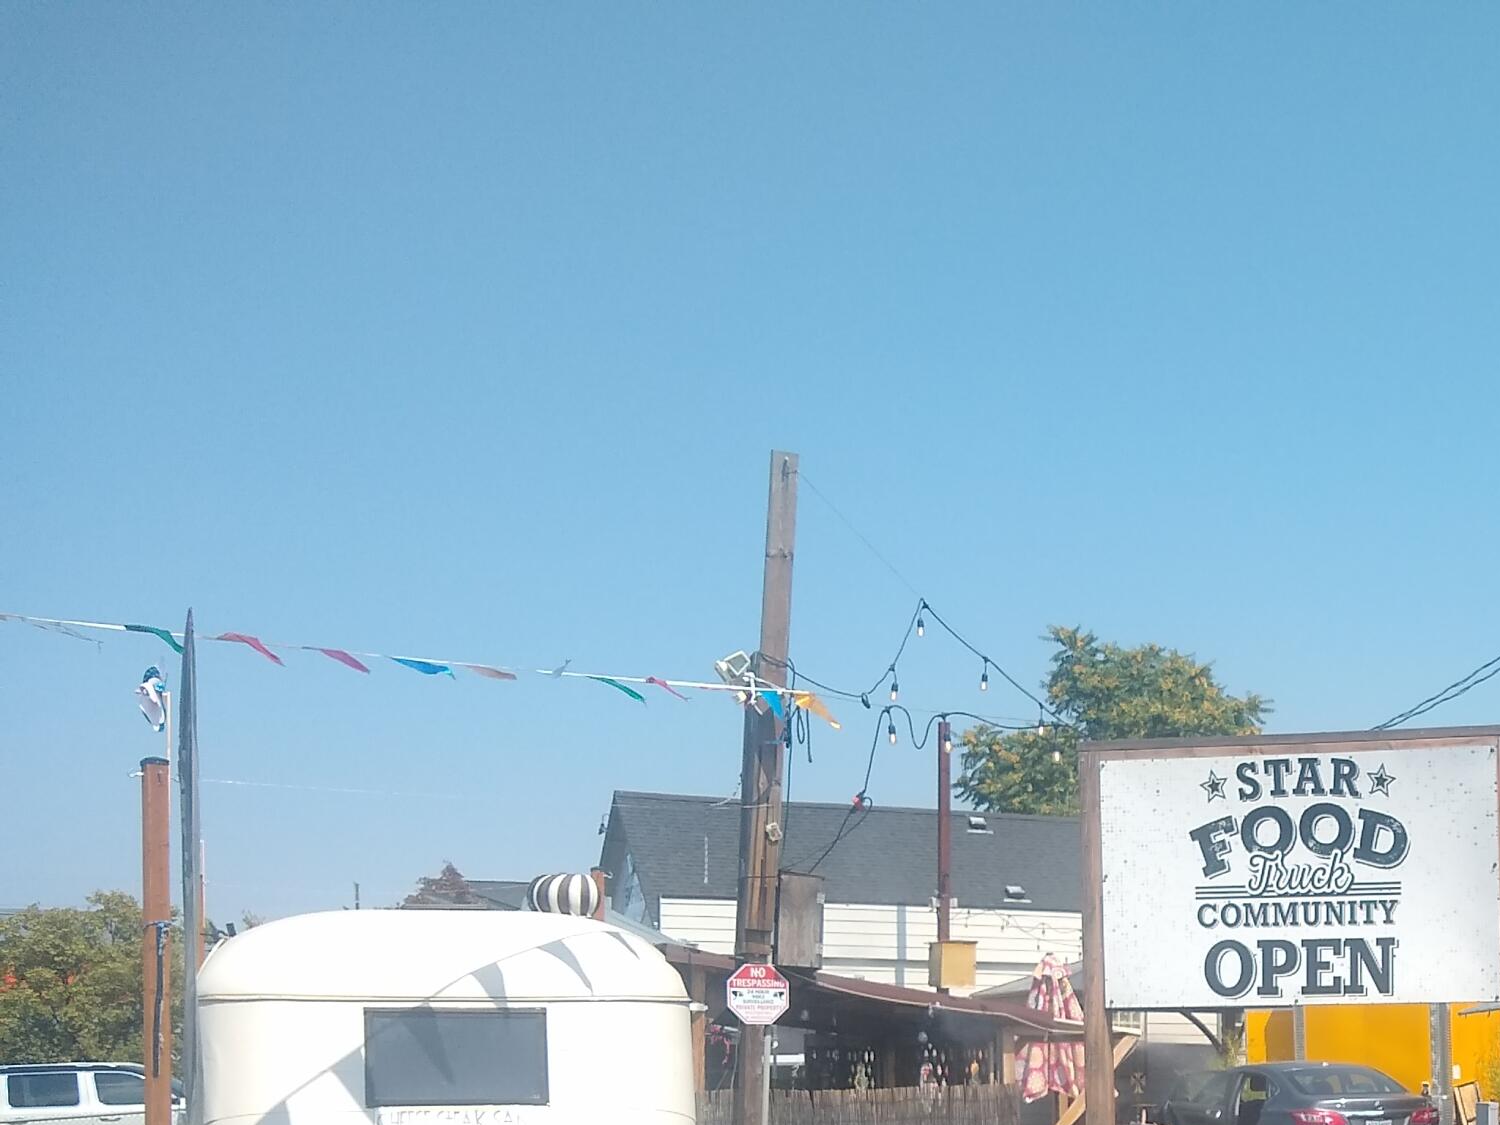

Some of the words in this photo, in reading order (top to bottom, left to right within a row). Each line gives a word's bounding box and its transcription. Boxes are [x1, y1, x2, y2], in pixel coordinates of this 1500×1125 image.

[1234, 756, 1362, 801] STAR
[1188, 802, 1411, 879] FOOD
[1245, 849, 1355, 896] Truck
[1196, 898, 1401, 929] COMMUNITY
[732, 978, 785, 988] TRESPASSING
[750, 967, 766, 978] NO
[1203, 936, 1400, 999] OPEN
